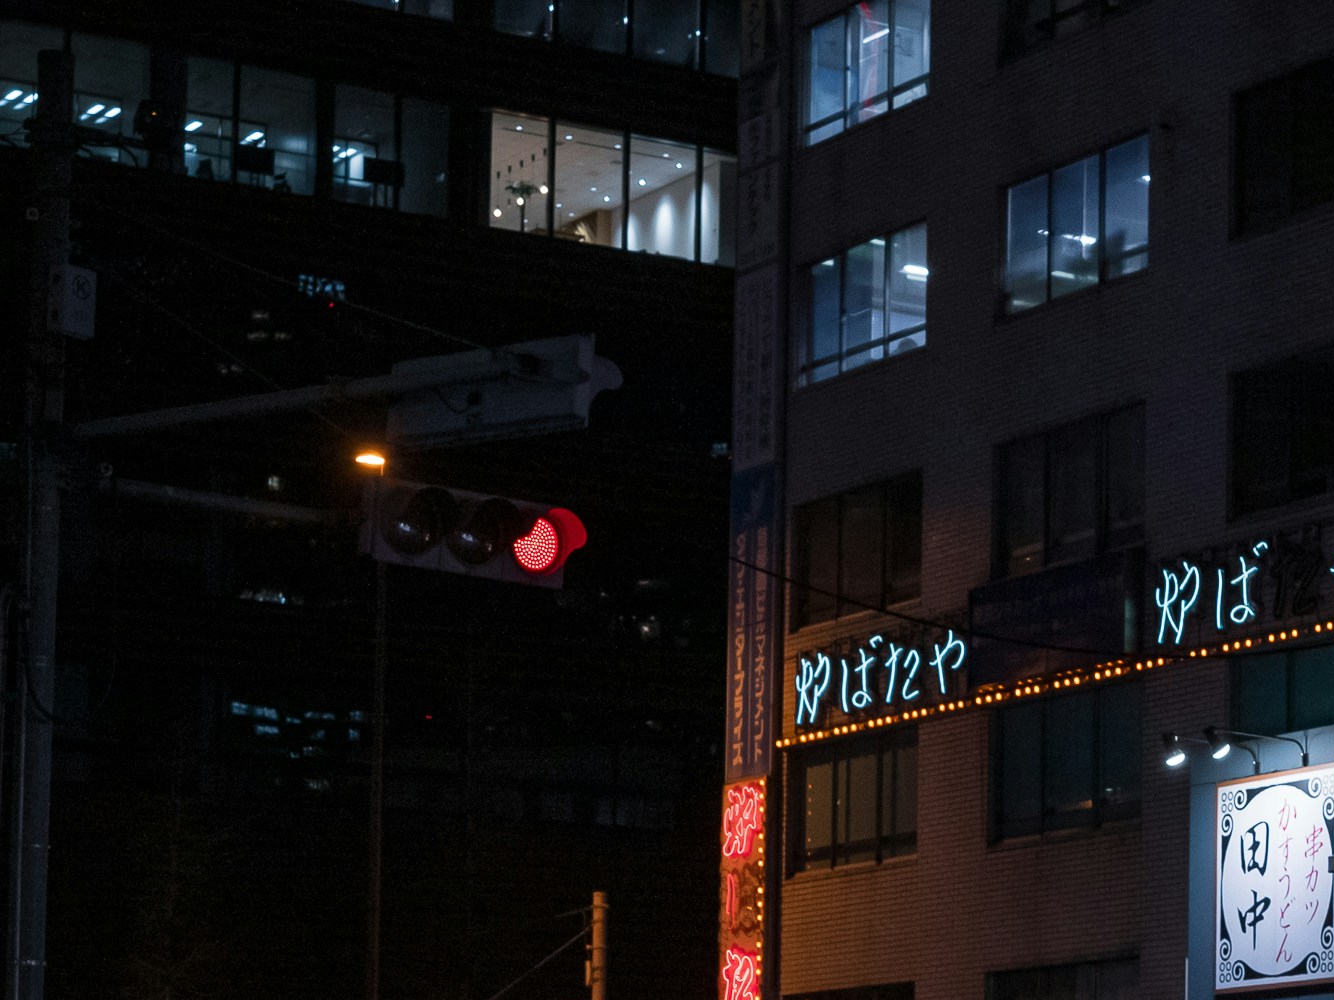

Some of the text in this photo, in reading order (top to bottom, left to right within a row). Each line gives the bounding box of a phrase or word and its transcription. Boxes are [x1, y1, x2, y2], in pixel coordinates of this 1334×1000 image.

[796, 629, 965, 725] 炉ばたや
[1237, 821, 1271, 951] 田中
[1276, 798, 1297, 964] かすうどん
[1304, 824, 1325, 925] 串カツ
